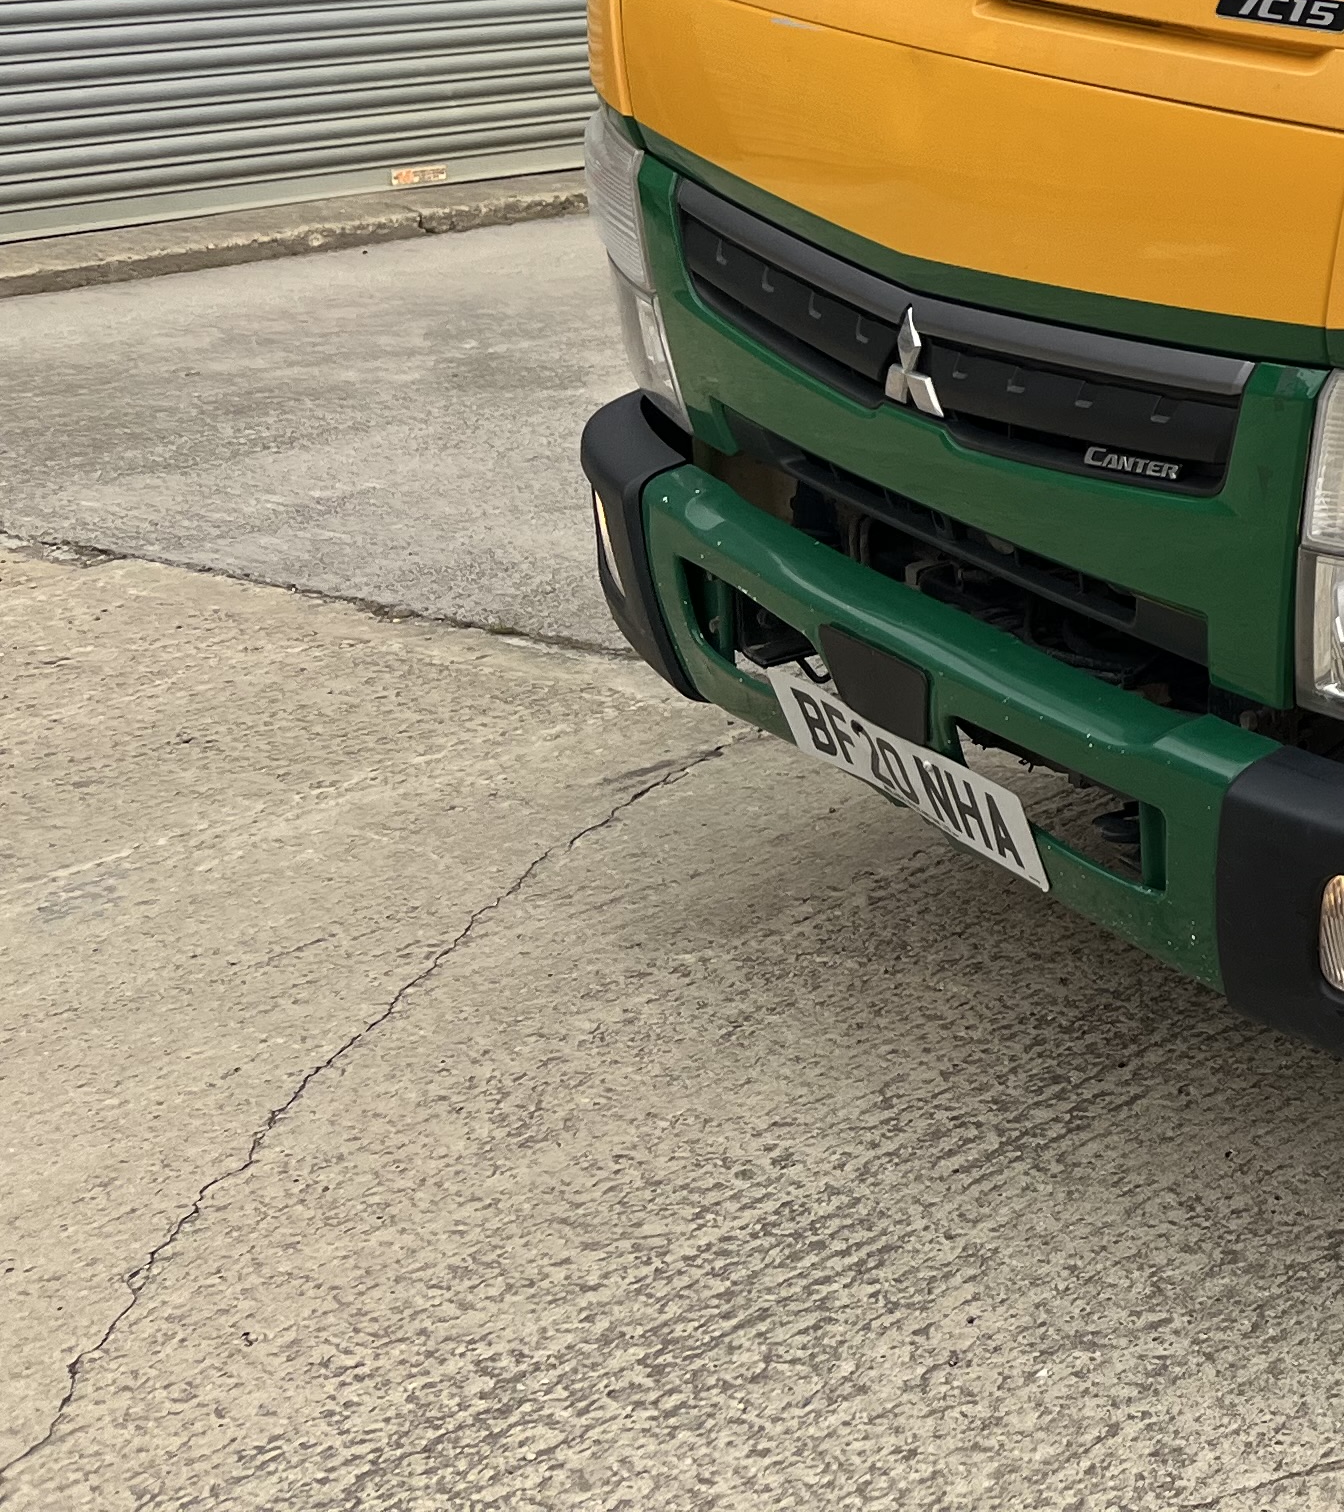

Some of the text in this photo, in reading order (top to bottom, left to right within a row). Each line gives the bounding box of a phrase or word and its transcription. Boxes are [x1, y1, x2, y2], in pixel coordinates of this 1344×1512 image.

[1083, 446, 1179, 480] CANTER
[790, 686, 919, 805] BF20
[913, 755, 1025, 870] NHA
